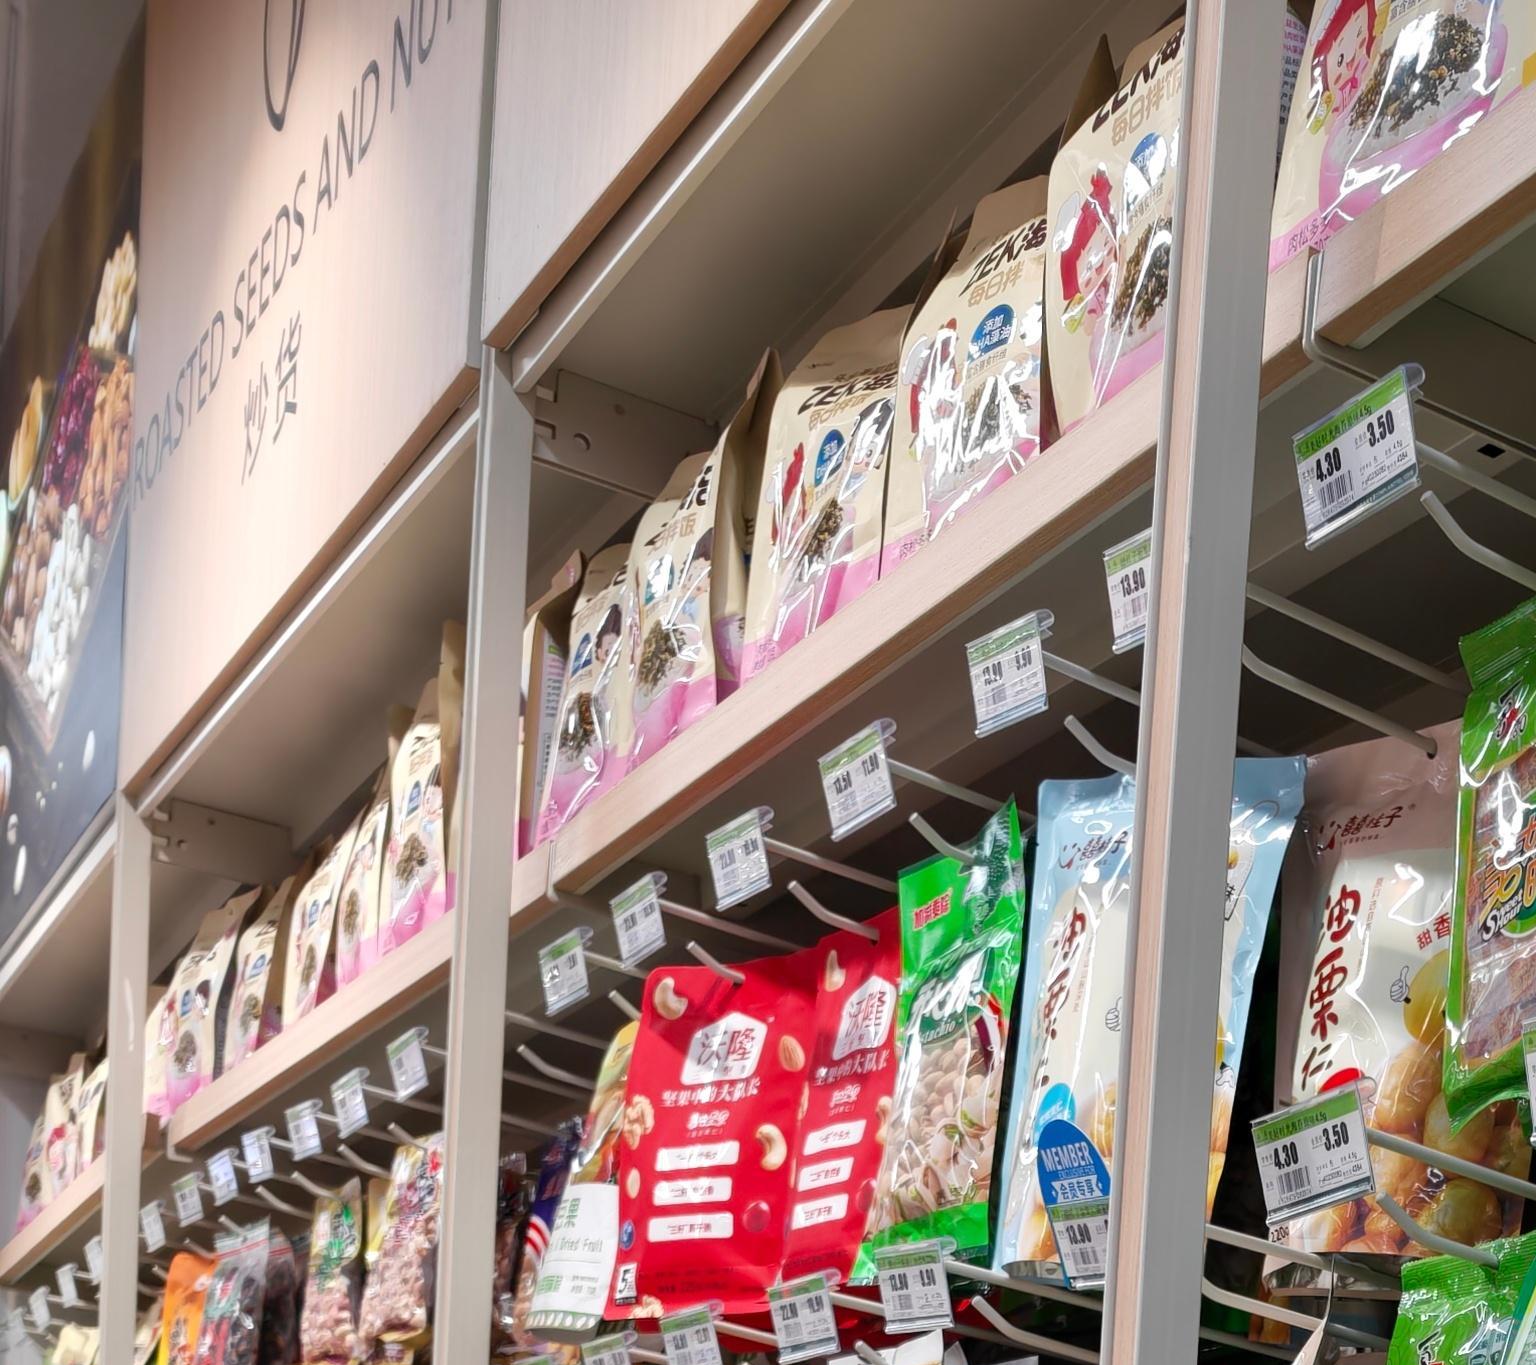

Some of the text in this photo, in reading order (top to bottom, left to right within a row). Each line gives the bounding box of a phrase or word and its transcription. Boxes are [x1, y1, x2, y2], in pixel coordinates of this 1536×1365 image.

[231, 169, 306, 359] SEEDS
[312, 59, 380, 235] AND
[241, 311, 302, 485] 炒货
[1315, 409, 1395, 482] 4.30 3.50
[1119, 566, 1146, 596] 13.90
[1041, 1141, 1093, 1172] MEMBER
[1273, 1125, 1350, 1173] 4.30 3.50
[1059, 1178, 1096, 1198] 会员专享
